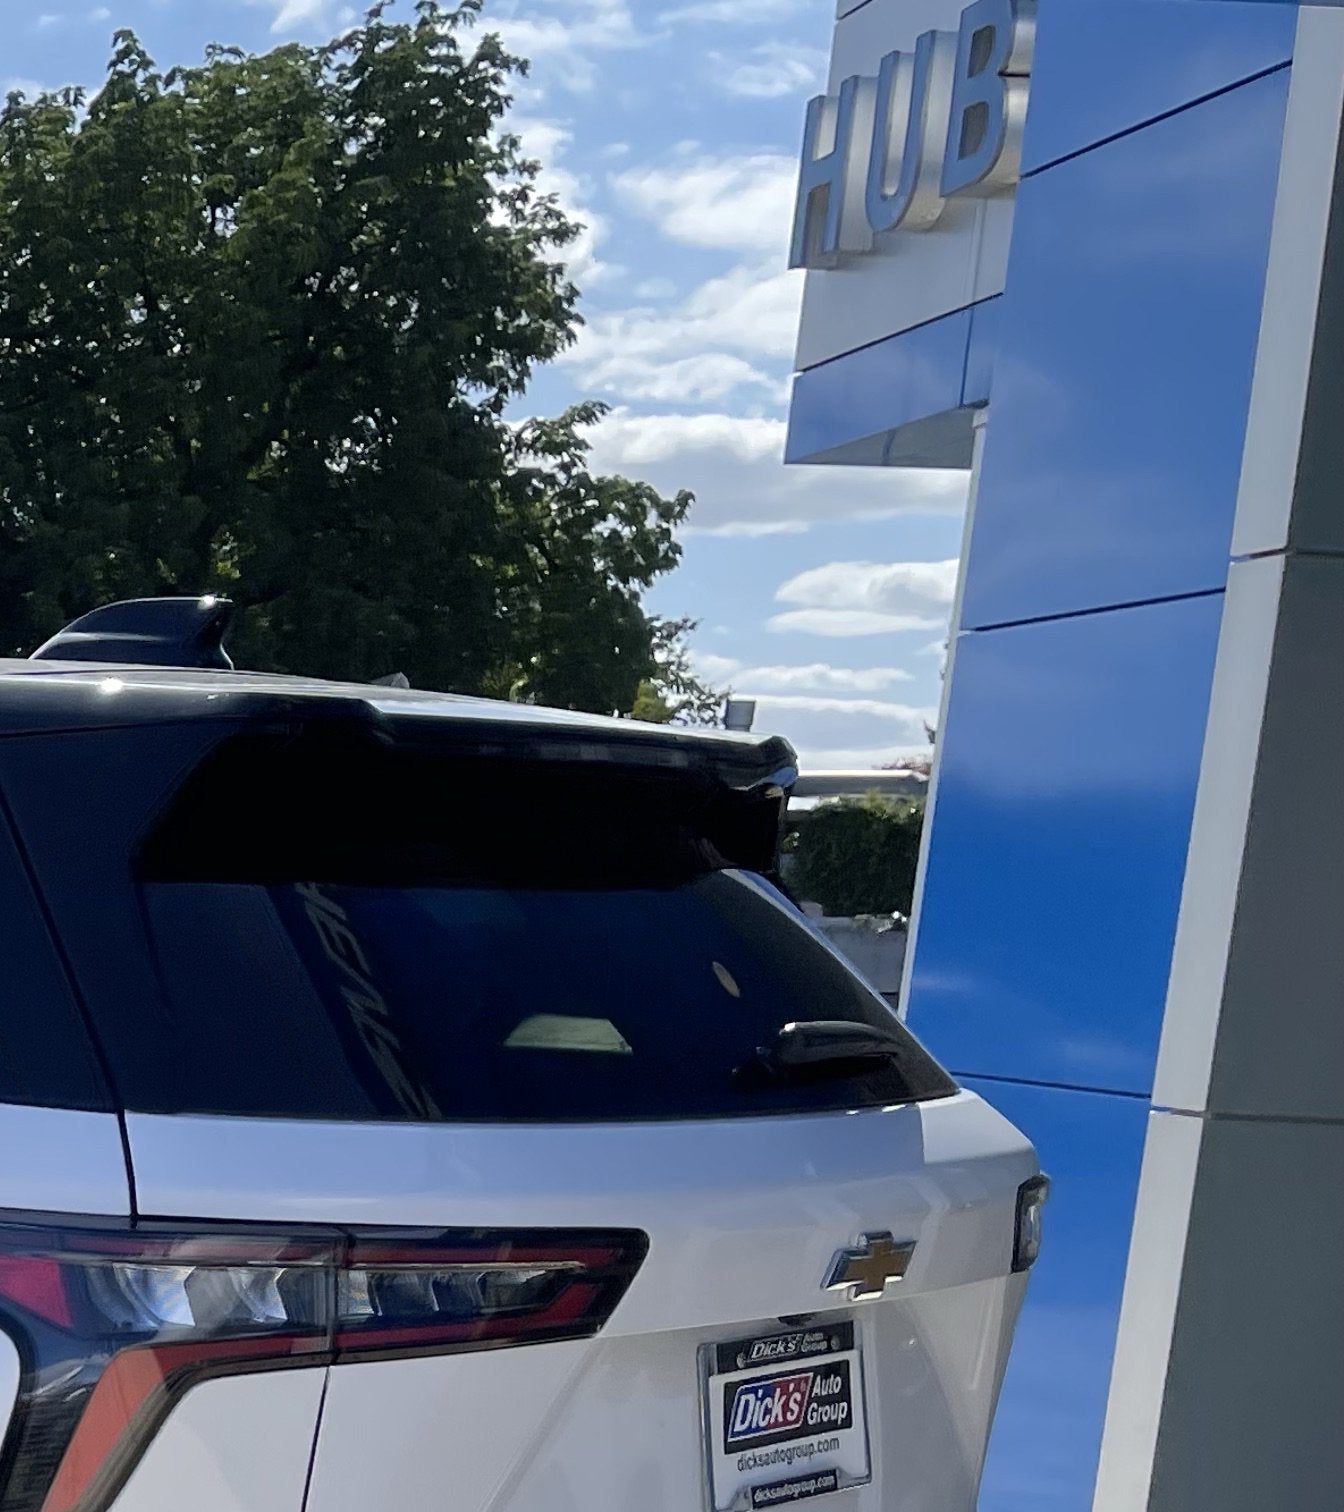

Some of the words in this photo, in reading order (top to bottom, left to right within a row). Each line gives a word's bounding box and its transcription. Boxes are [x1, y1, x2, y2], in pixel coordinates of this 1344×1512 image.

[733, 1383, 802, 1432] Dick's
[812, 1374, 842, 1398] Auto
[807, 1402, 848, 1425] Group
[737, 1437, 840, 1472] dicksautogroup.com
